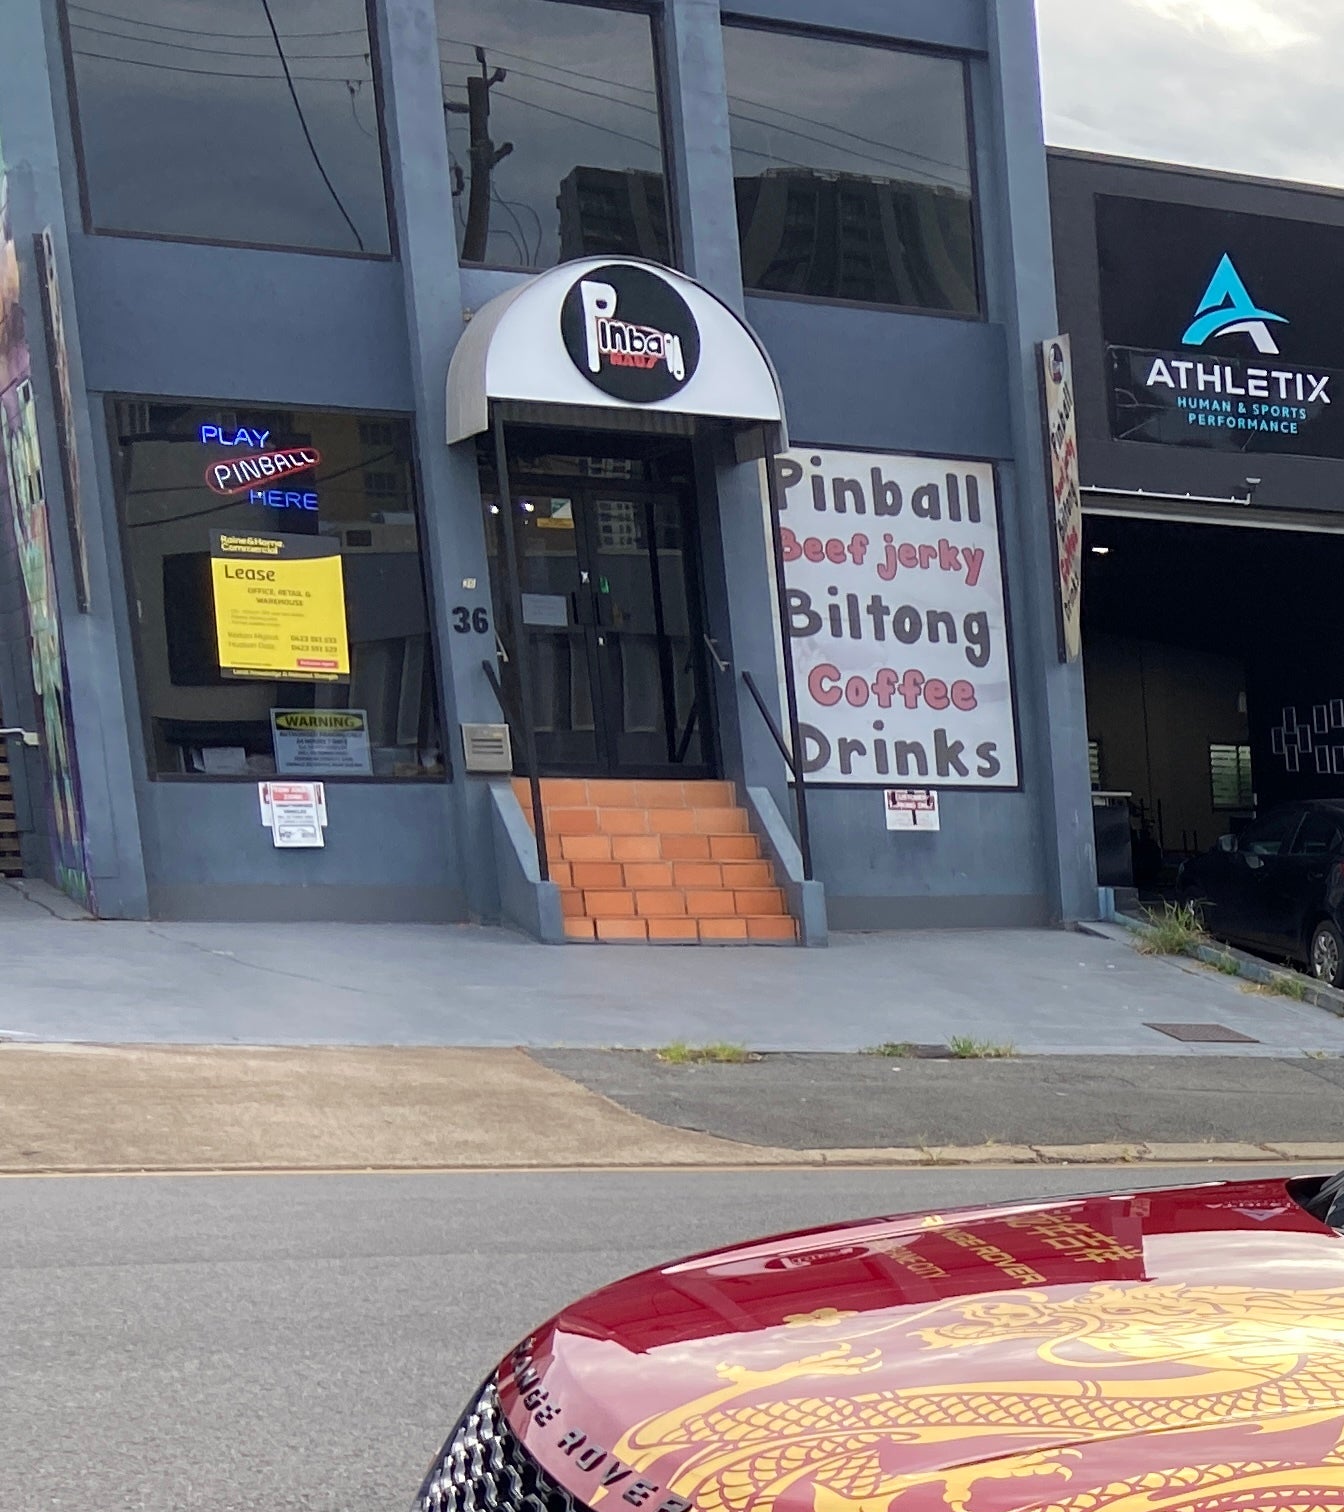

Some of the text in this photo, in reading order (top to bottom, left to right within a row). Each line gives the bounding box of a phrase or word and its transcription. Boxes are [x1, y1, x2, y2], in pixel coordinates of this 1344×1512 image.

[1146, 358, 1331, 404] ATHLETIX
[1177, 396, 1306, 420] HUMAN & SPORTS
[1188, 413, 1298, 434] PERFORMANCE
[201, 425, 270, 449] PLAY
[214, 451, 315, 489] PINBALL
[250, 489, 320, 511] HERE
[774, 456, 981, 524] Pinball
[224, 564, 276, 582] Lease
[780, 527, 985, 587] Beef jerky
[452, 606, 489, 634] 36
[786, 585, 991, 667] Biltong
[808, 663, 978, 712] Coffee
[285, 716, 354, 728] WARNING
[799, 720, 1001, 778] Drinks
[972, 1246, 1048, 1286] ROVER
